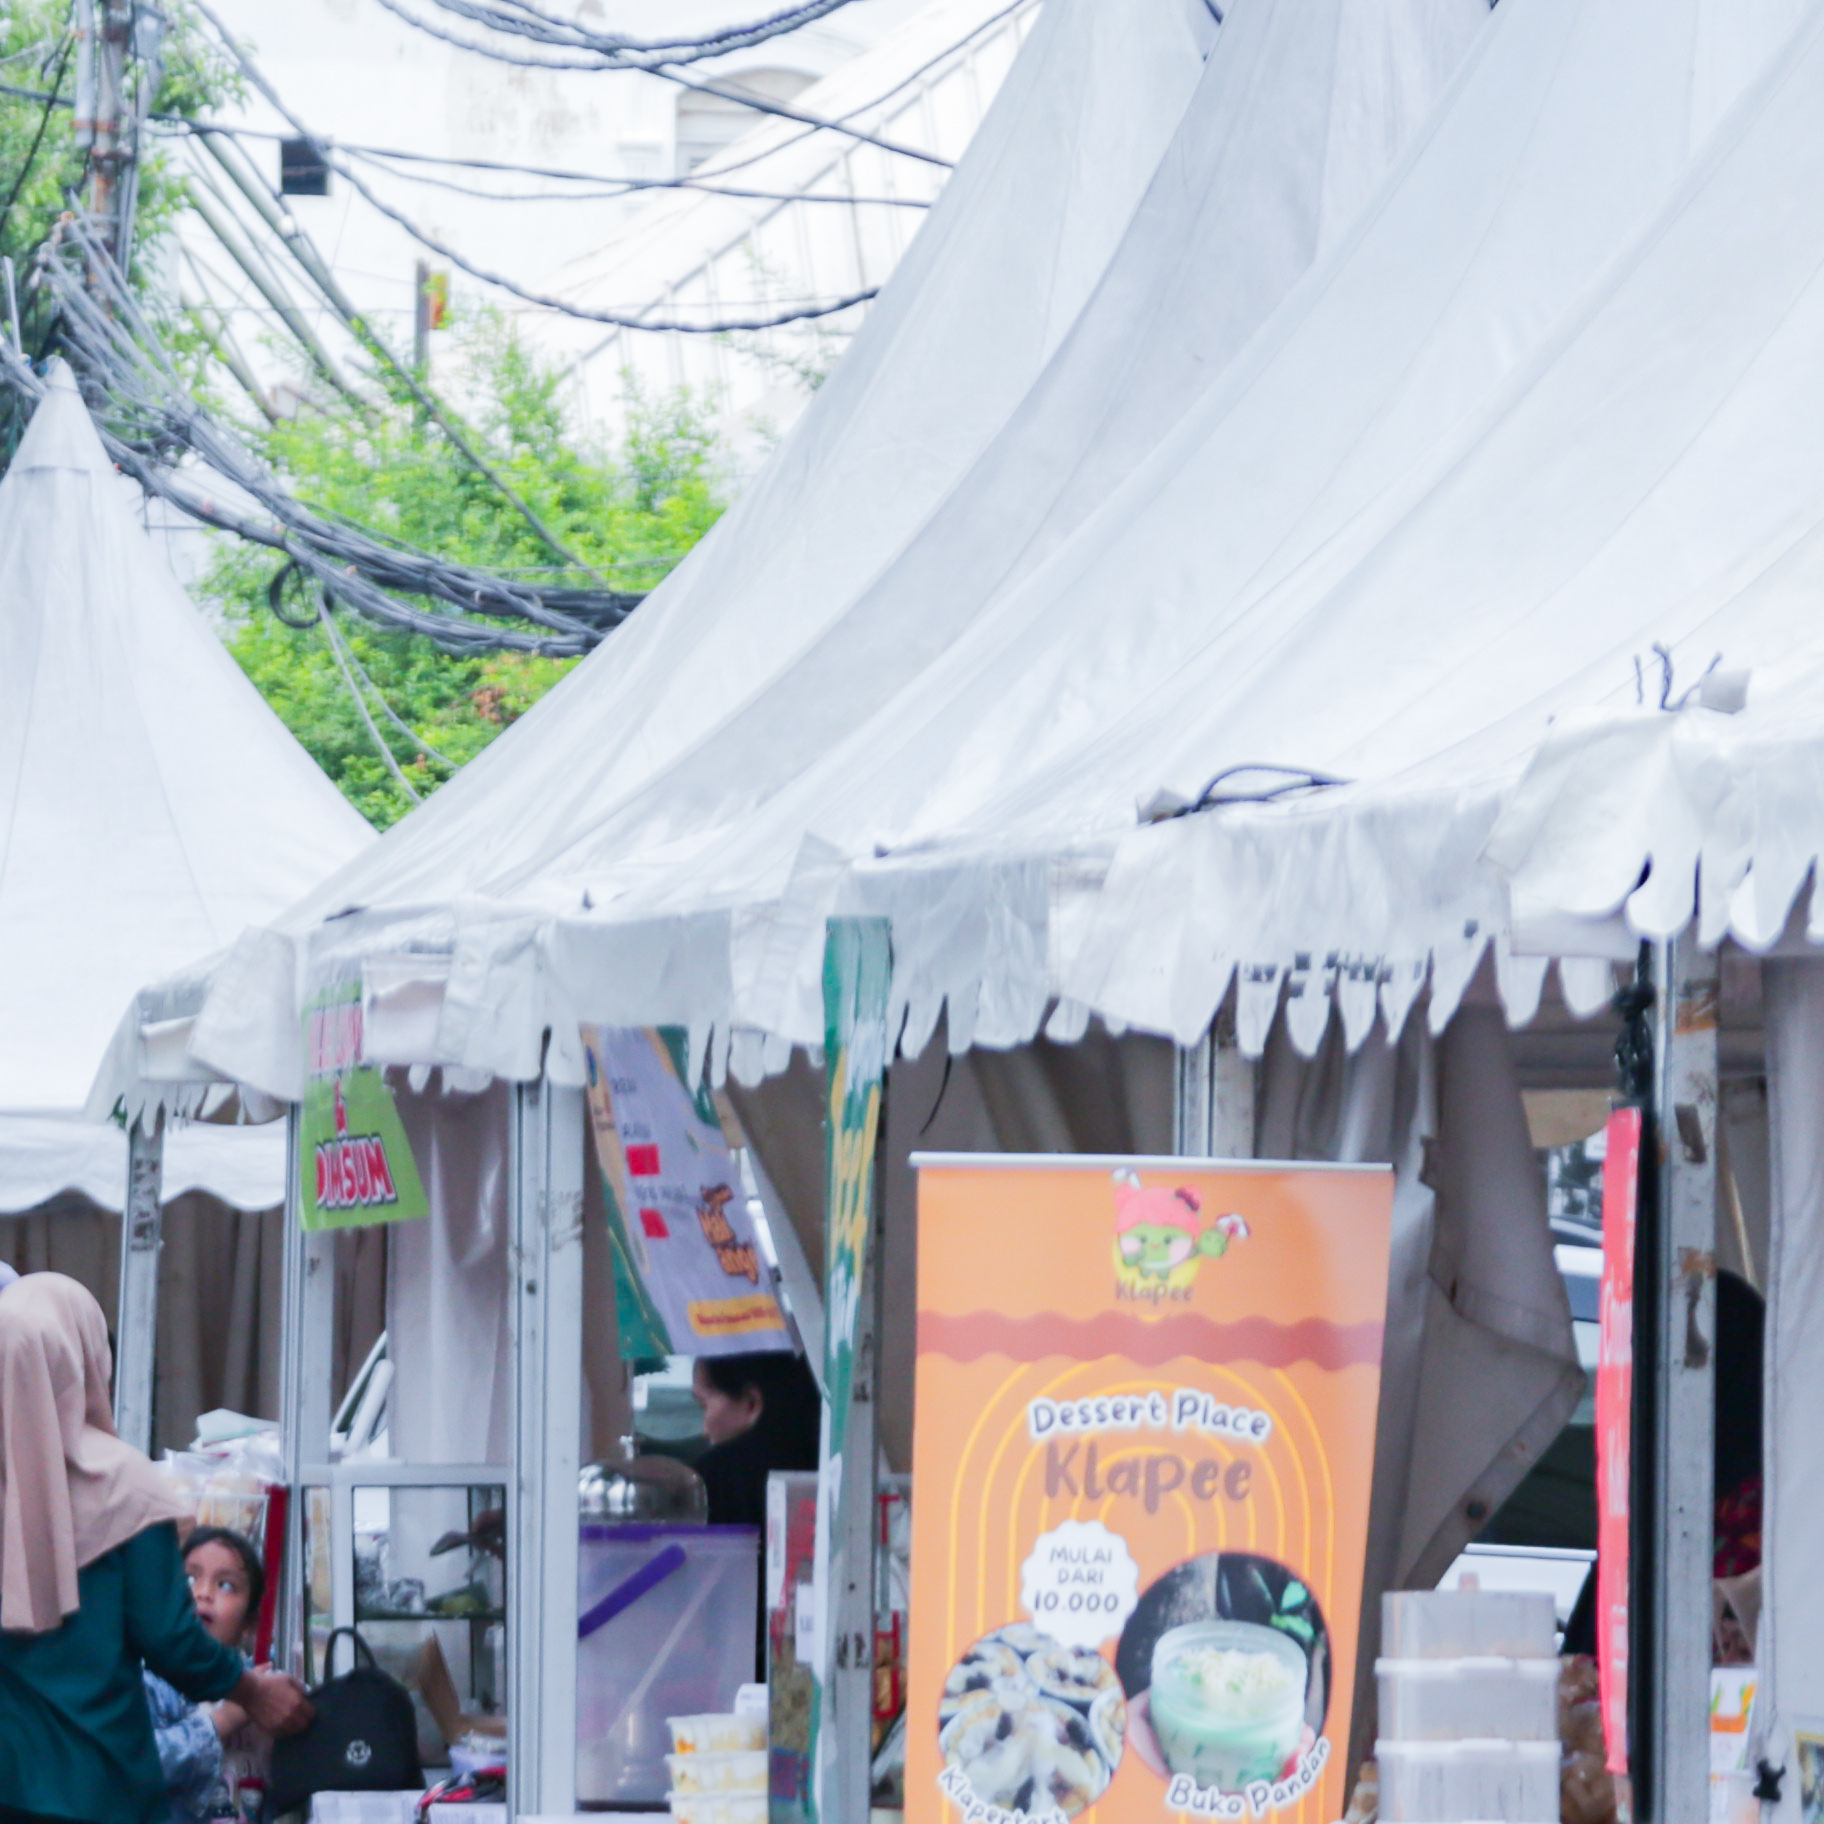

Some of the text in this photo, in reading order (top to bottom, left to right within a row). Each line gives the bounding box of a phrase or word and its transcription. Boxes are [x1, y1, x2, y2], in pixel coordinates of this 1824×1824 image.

[1114, 1281, 1195, 1305] Klapee
[1034, 1394, 1268, 1437] Dessert Place
[1045, 1442, 1252, 1514] Klapee
[1050, 1544, 1112, 1565] MULAI
[1057, 1567, 1104, 1586] DARI
[1033, 1591, 1120, 1614] 10.000
[1170, 1740, 1329, 1815] Buko Pandan
